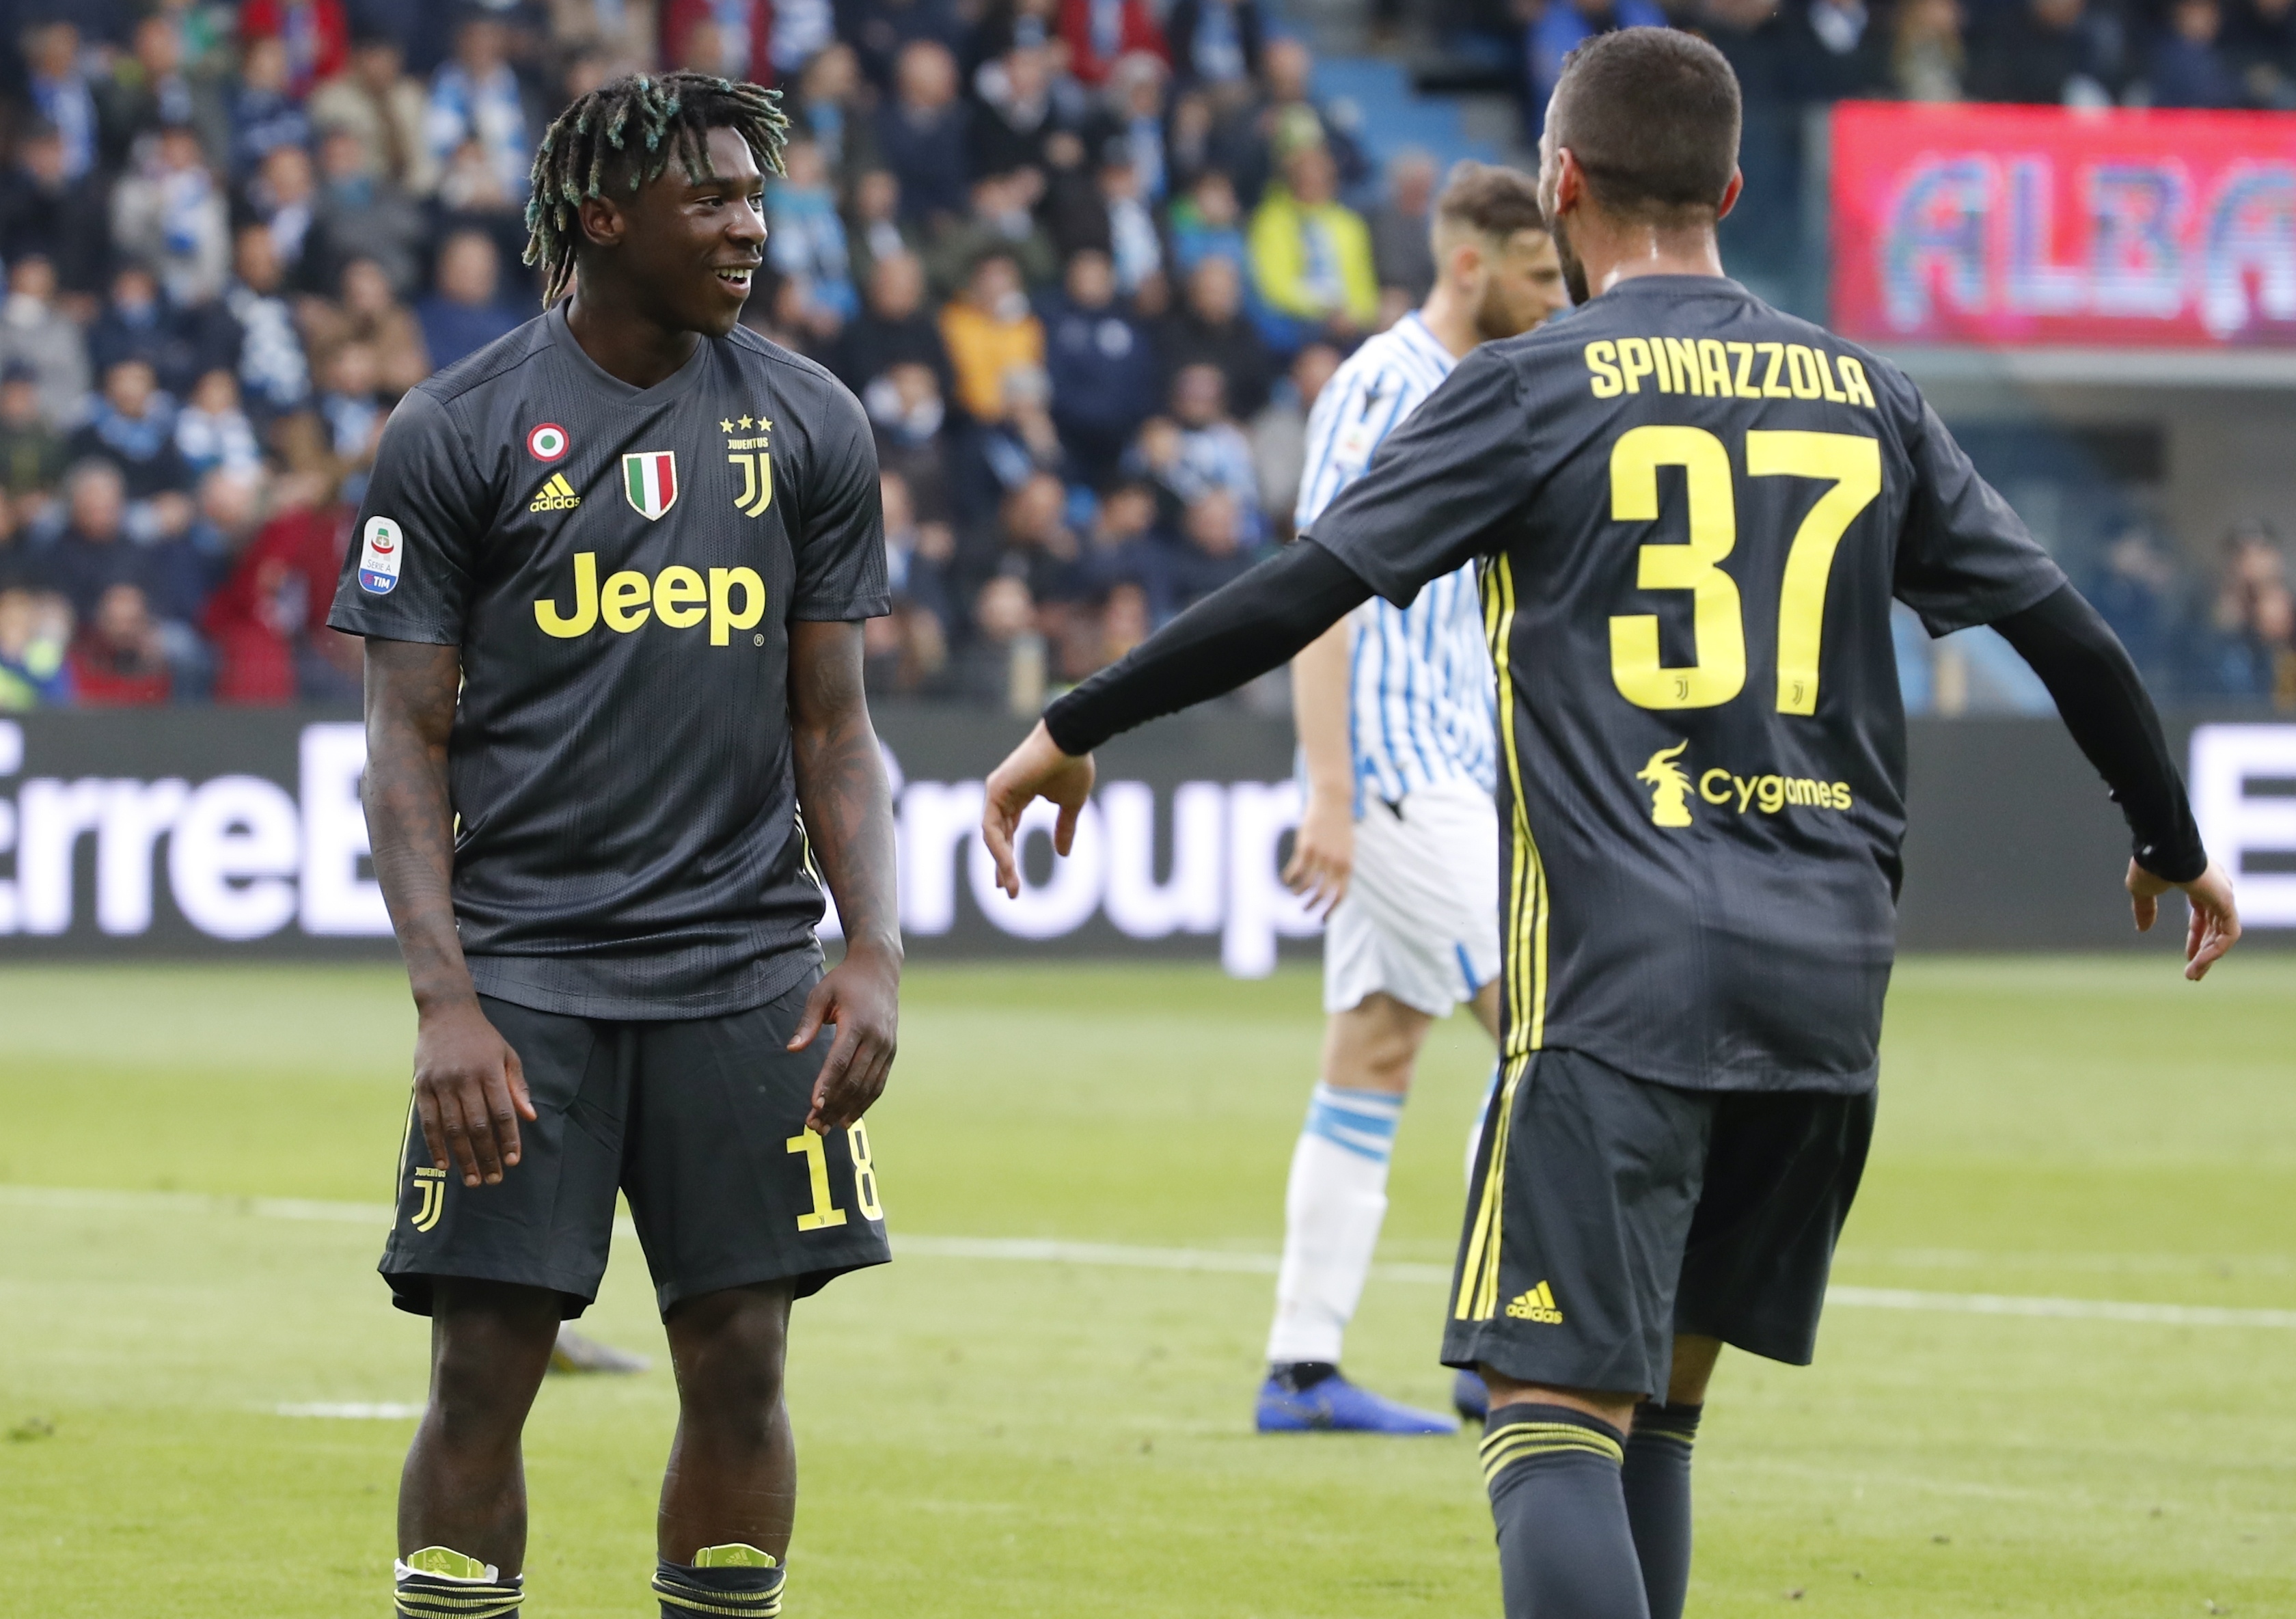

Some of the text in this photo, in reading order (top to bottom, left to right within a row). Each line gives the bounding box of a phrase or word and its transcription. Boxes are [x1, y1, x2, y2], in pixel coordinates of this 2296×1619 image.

[1584, 337, 1876, 409] SPINAZZOLA
[727, 437, 769, 450] JUVENTUS
[529, 495, 581, 513] adidas
[367, 559, 392, 573] SERIE A
[374, 576, 390, 588] TIM
[1609, 424, 1881, 716] 37
[534, 552, 765, 647] Jeep
[1699, 768, 1852, 814] Cygames
[786, 1116, 884, 1232] 18
[1505, 1303, 1563, 1324] adidas
